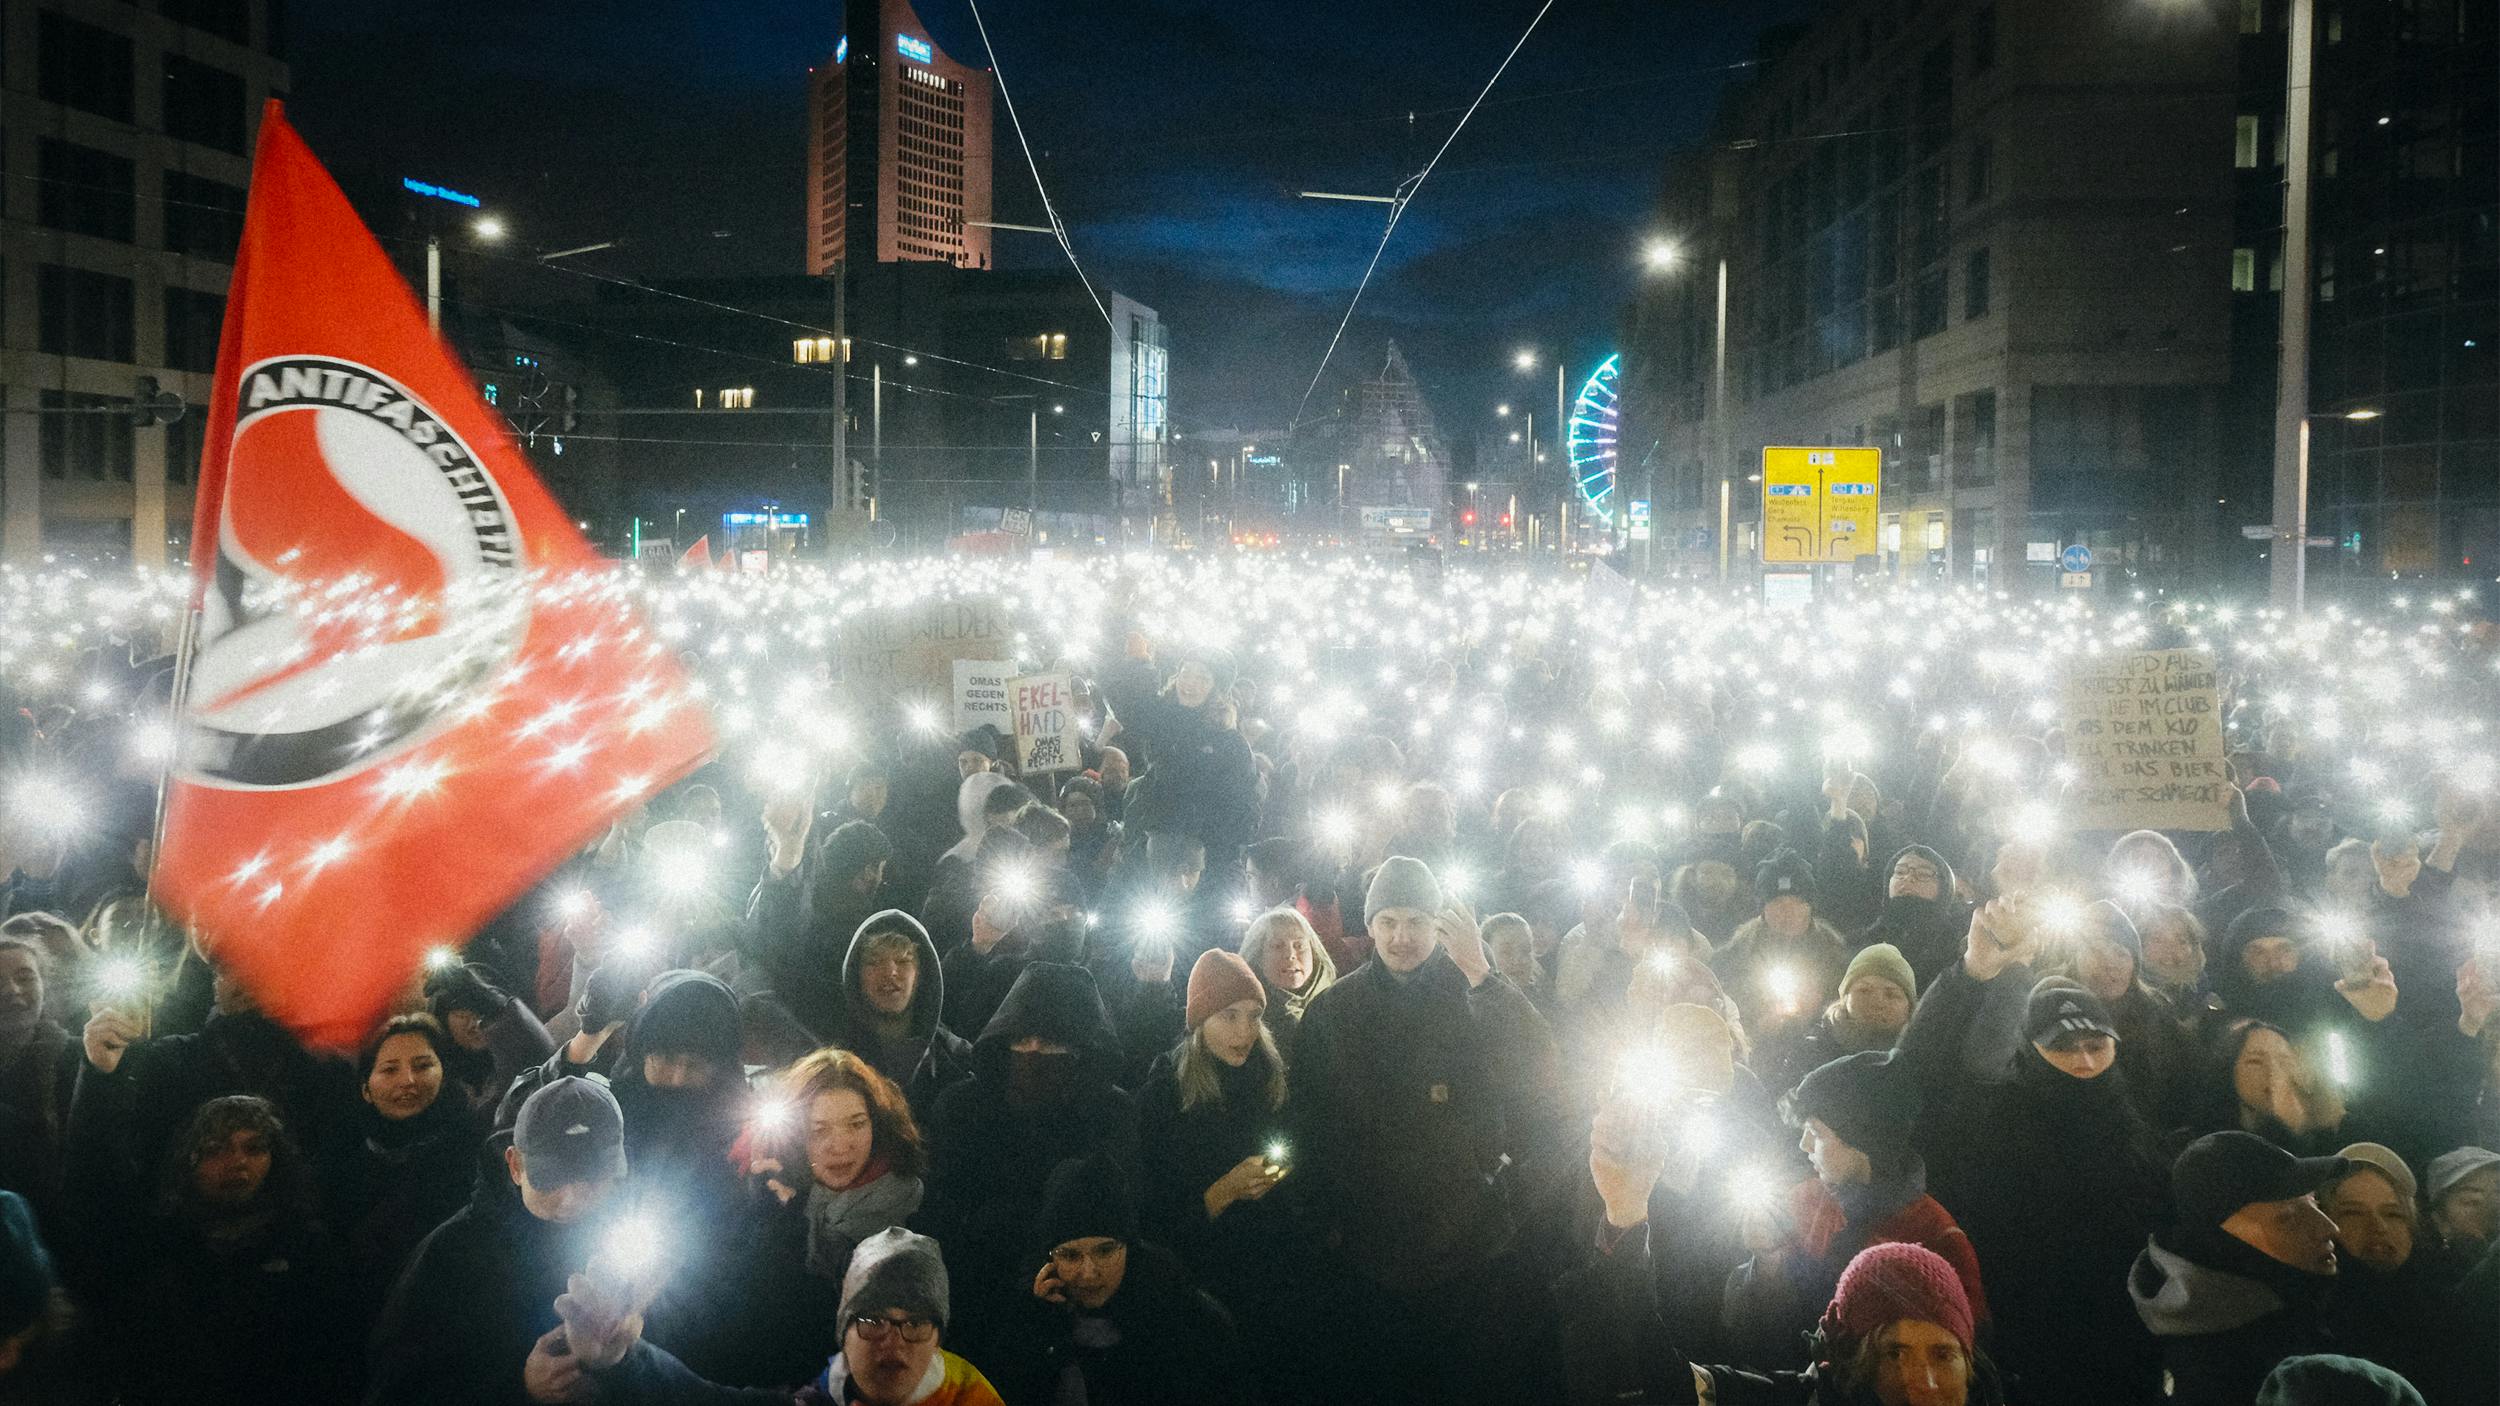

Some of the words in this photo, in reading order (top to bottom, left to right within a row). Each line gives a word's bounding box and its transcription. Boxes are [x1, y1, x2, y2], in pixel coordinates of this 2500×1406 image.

[248, 366, 514, 570] ANTIFASCHISTI
[2164, 653, 2202, 672] AUS
[969, 676, 1001, 686] OMAS
[2137, 677, 2162, 695] ZU
[966, 689, 1005, 699] GEGEN
[1018, 682, 1069, 711] EKEL-
[964, 702, 1008, 712] RECHTS
[2164, 696, 2211, 715] CLUB
[2111, 720, 2153, 735] DEM
[1034, 736, 1061, 748] OMAS
[2112, 739, 2197, 757] TRINKEN
[1027, 754, 1065, 768] RECHTS
[1029, 746, 1060, 760] GEGEN
[2122, 759, 2160, 778] DAS
[2169, 760, 2223, 778] BIER
